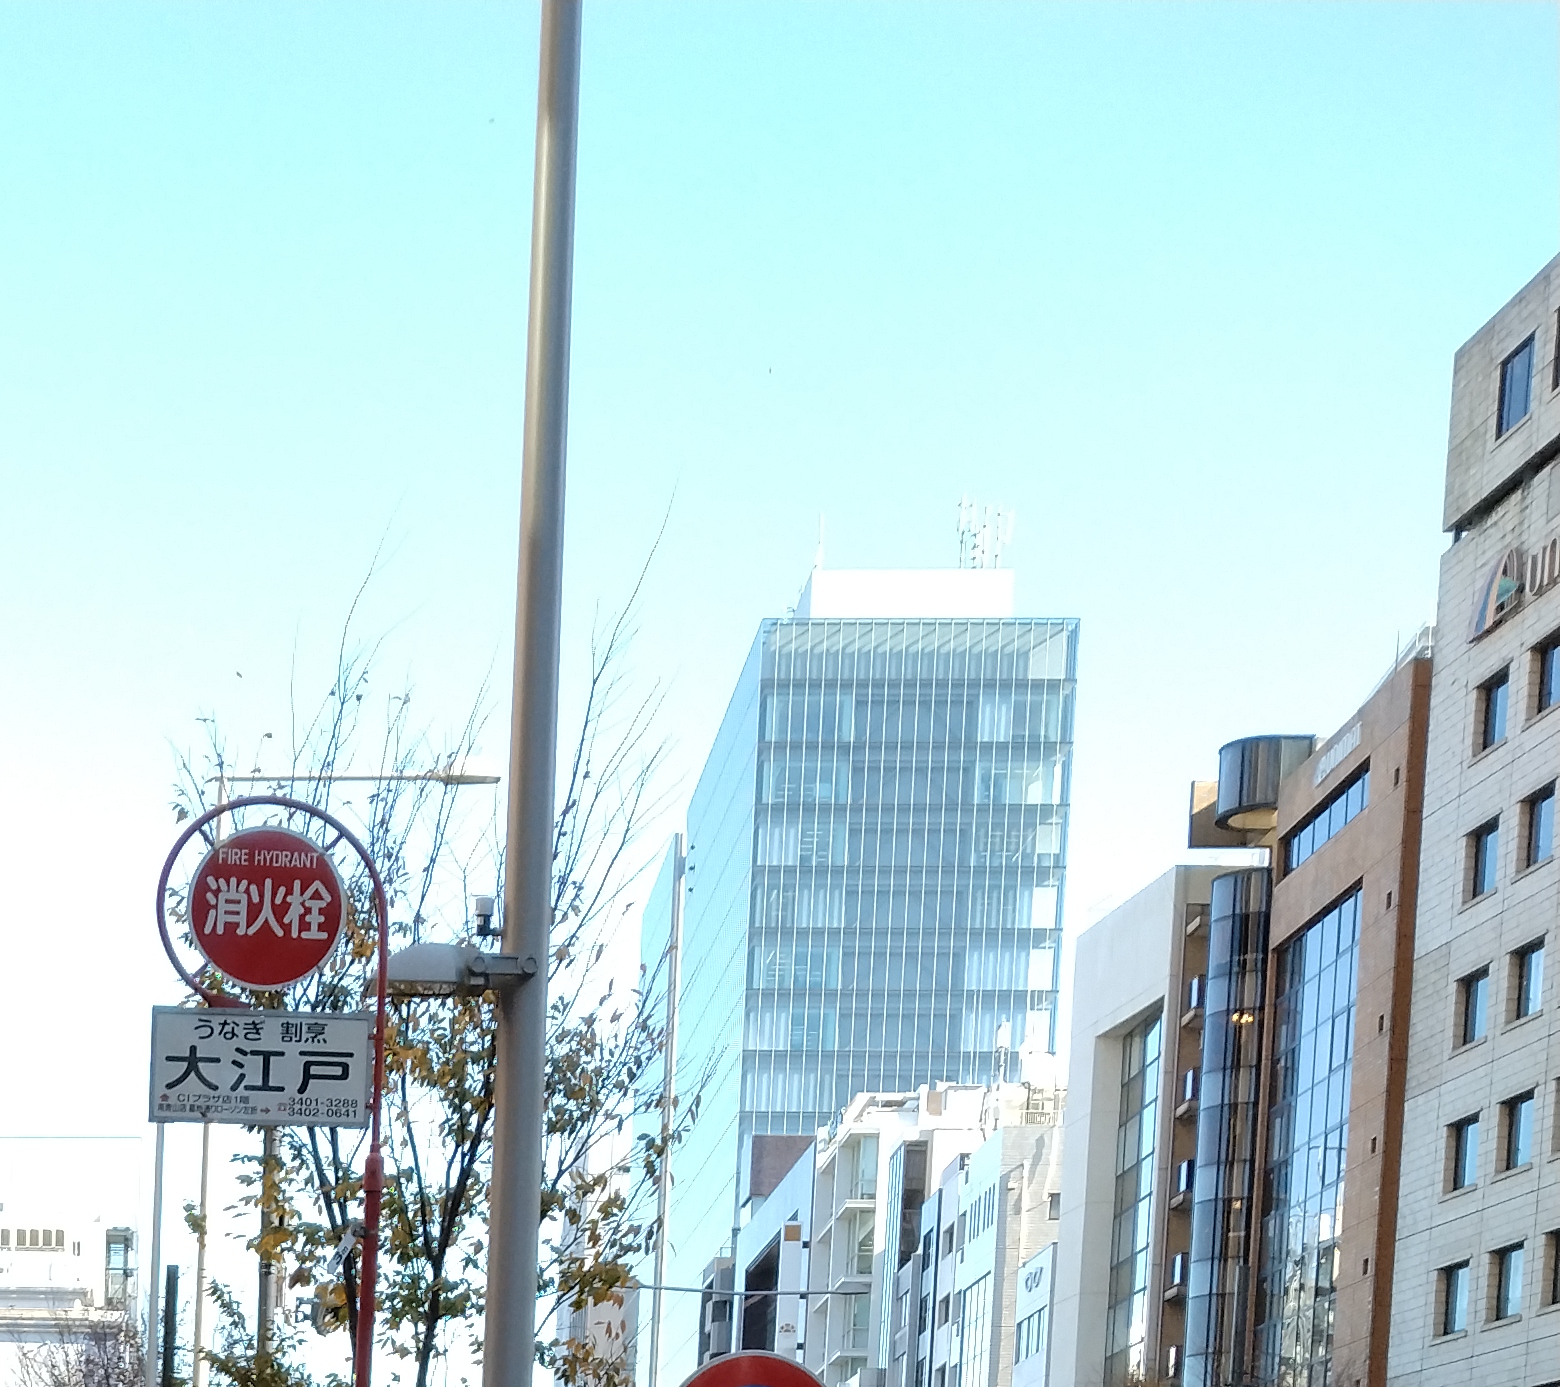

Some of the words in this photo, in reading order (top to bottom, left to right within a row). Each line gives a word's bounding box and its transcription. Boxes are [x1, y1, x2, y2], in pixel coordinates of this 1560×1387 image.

[219, 848, 249, 865] FIRE
[254, 850, 319, 869] HYDRANT
[204, 875, 333, 940] 消火栓
[193, 1018, 265, 1041] うなぎ
[280, 1021, 328, 1044] 割烹
[165, 1045, 355, 1095] 大江戸
[287, 1106, 358, 1119] 3402-0641
[288, 1096, 358, 1109] 3401-3288
